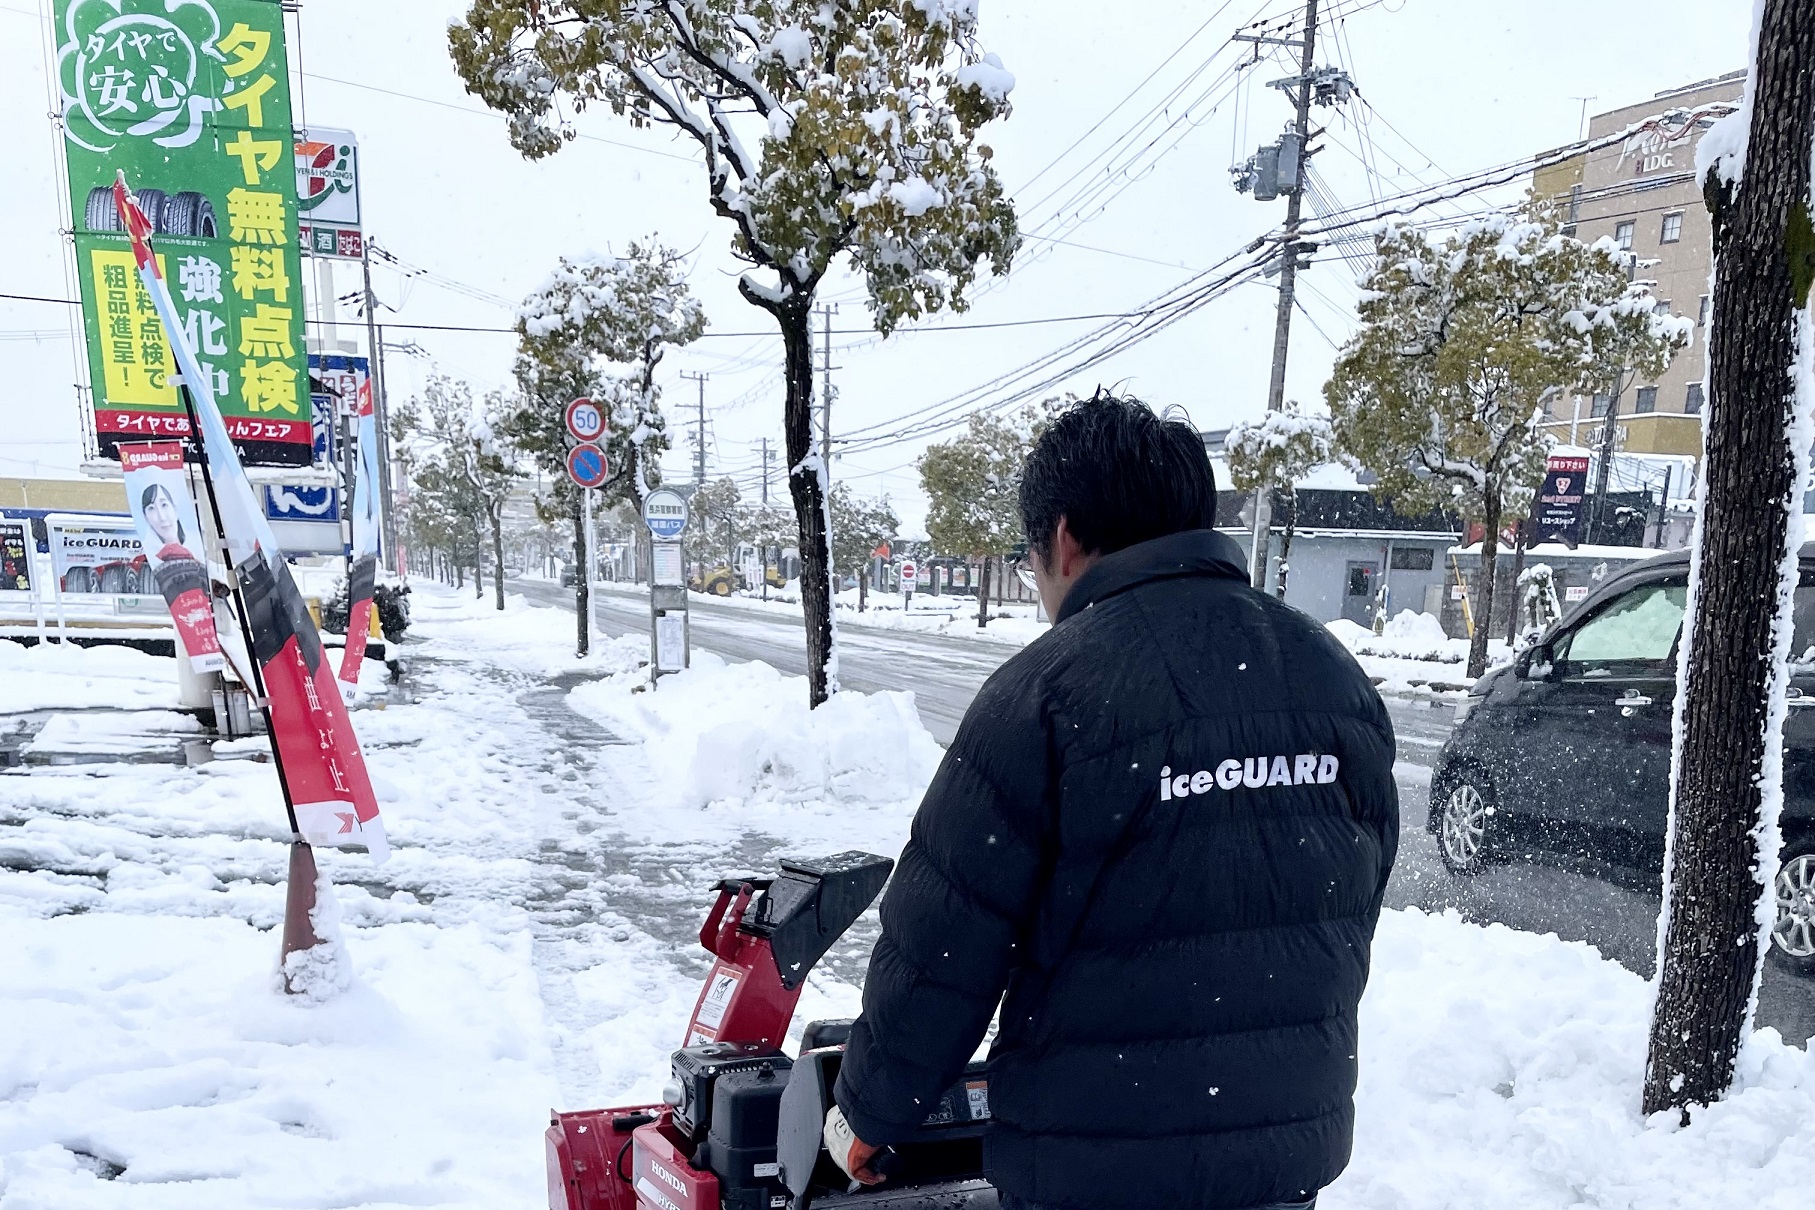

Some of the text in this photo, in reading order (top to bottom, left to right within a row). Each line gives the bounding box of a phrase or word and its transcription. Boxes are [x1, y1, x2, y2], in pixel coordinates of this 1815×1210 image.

[86, 30, 176, 63] タイヤで
[90, 65, 187, 116] 安心
[320, 169, 353, 180] HOLDINGS
[216, 22, 299, 414] タイヤ無料点検
[317, 231, 333, 250] 酒
[116, 415, 291, 437] タイヤであんフェア
[575, 410, 597, 430] 50
[63, 536, 142, 549] iceGUARD
[1160, 754, 1339, 801] iceGUARD
[651, 1159, 688, 1198] HONDA
